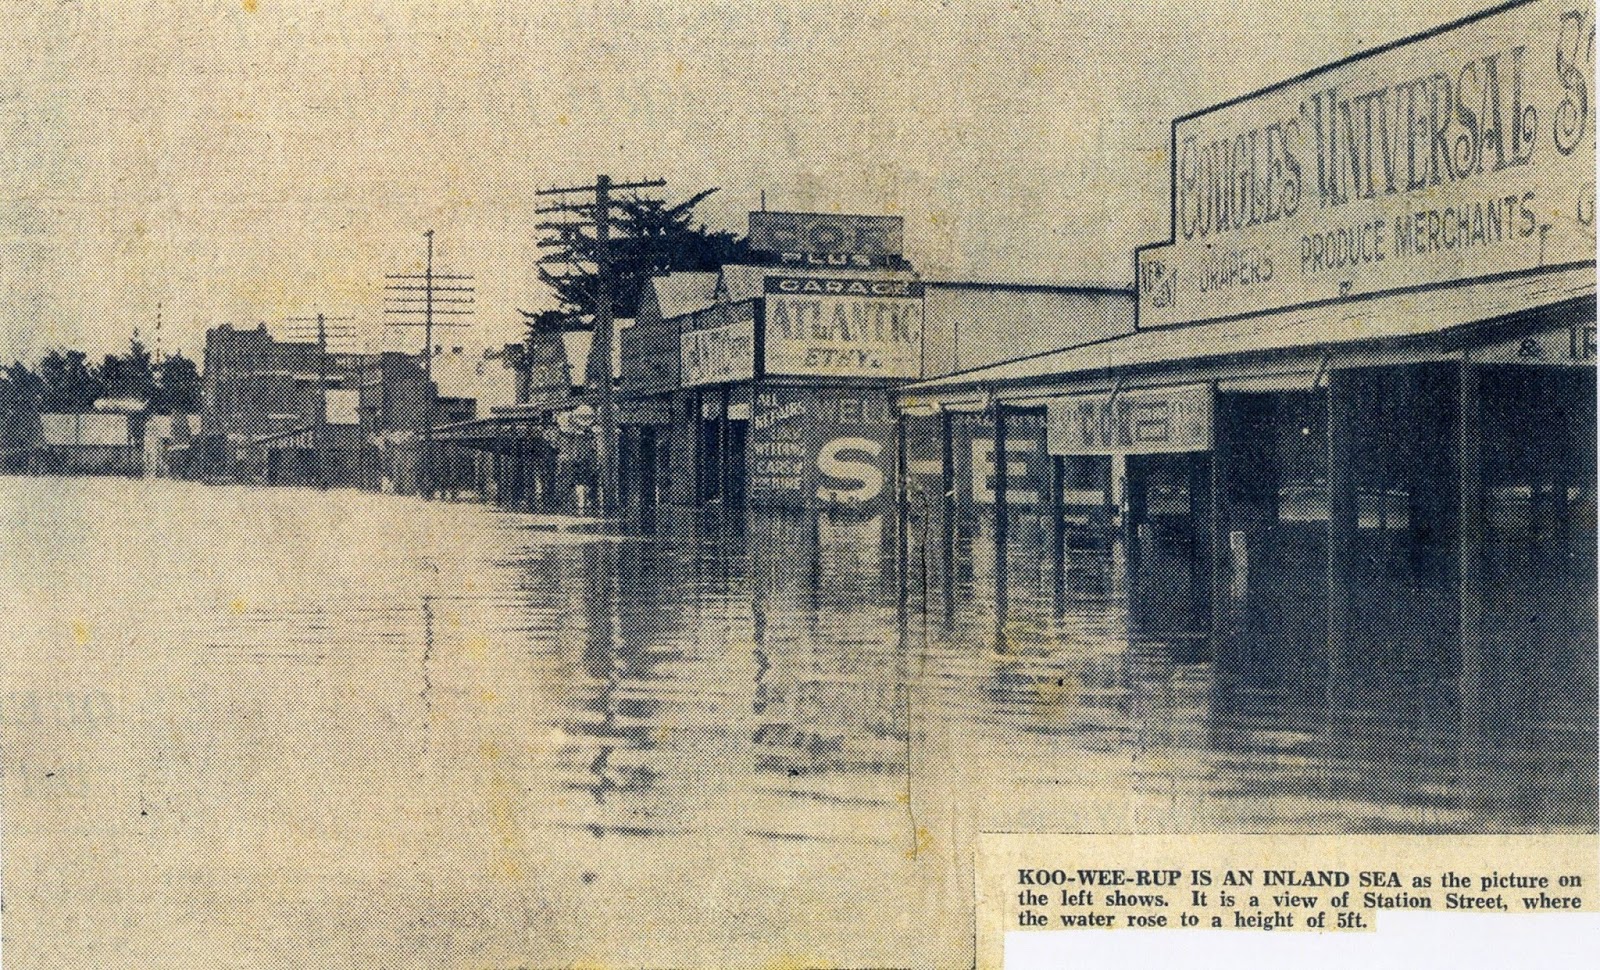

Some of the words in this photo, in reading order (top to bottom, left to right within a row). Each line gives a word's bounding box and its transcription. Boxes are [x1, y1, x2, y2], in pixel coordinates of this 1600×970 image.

[1310, 46, 1538, 209] UNIVERSAL
[1552, 8, 1595, 156] S
[781, 253, 871, 267] PLUS
[1300, 220, 1385, 274] PRODUCE
[1394, 192, 1535, 260] MERCHANTS
[773, 298, 921, 344] ATLANTIC
